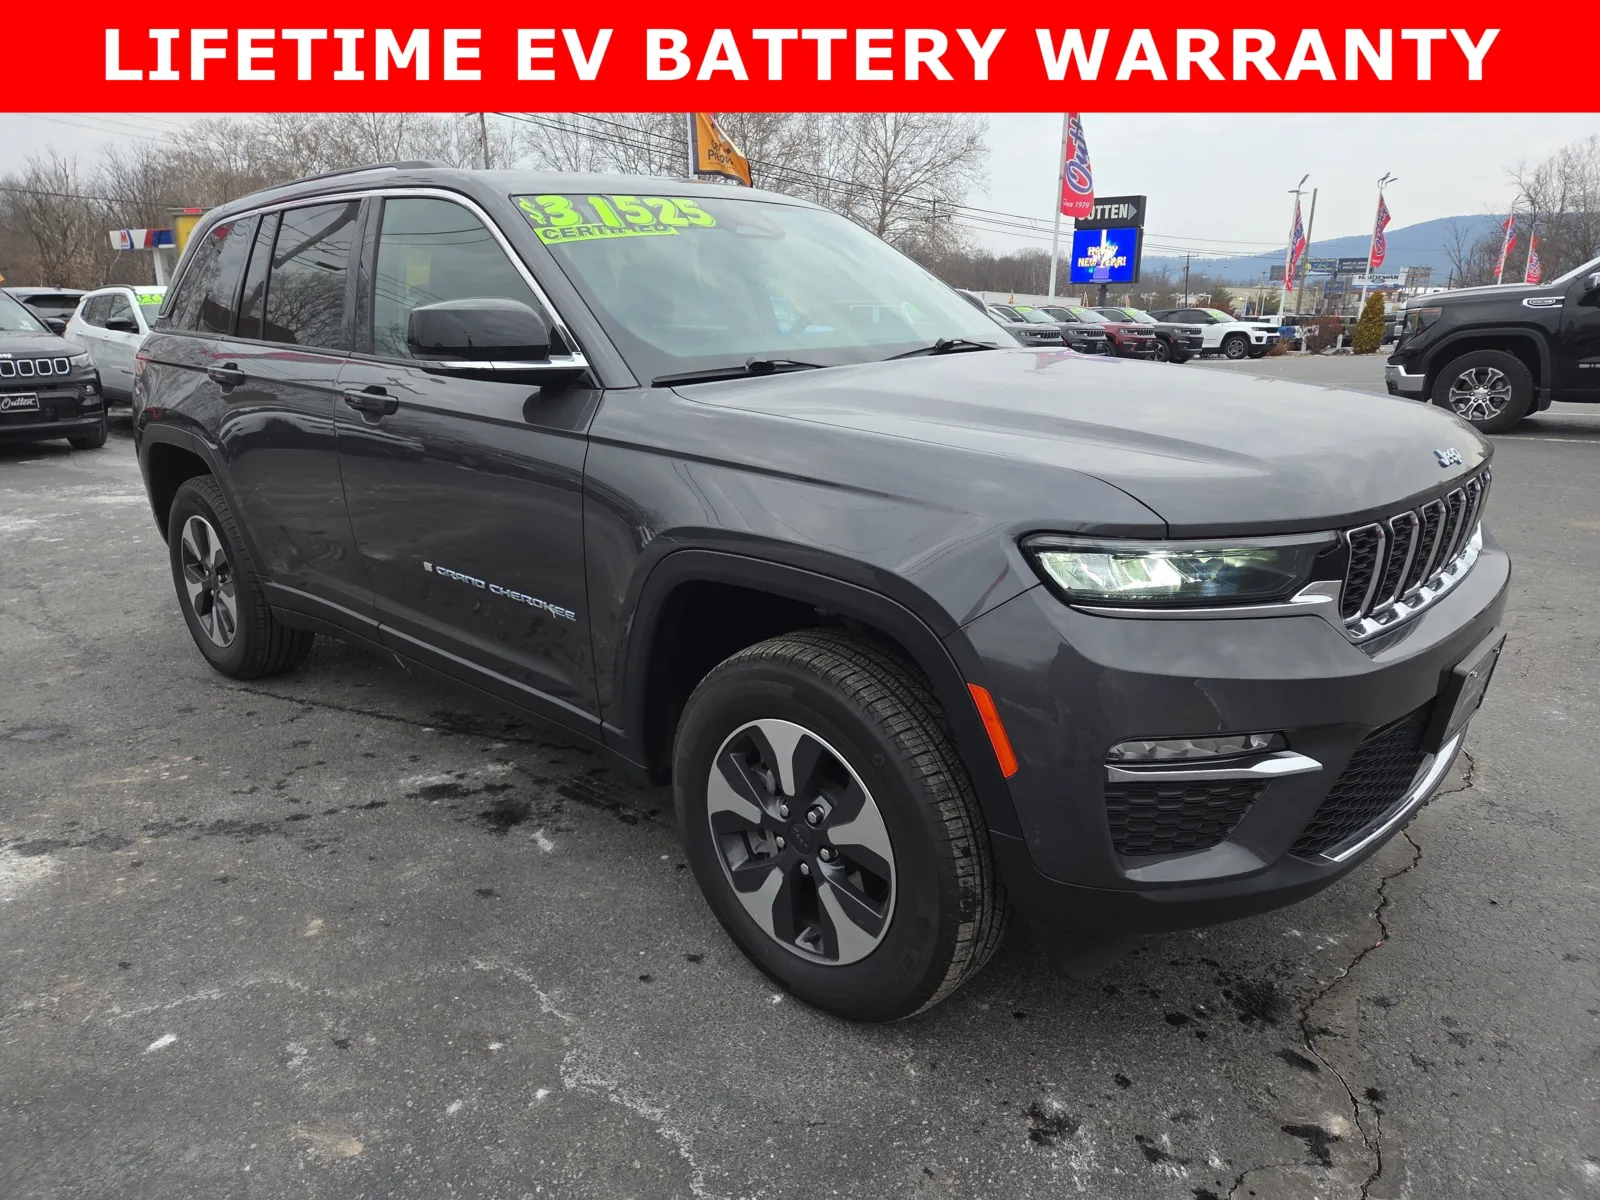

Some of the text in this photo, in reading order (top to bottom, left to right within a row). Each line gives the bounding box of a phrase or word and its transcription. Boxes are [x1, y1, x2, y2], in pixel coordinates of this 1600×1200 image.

[518, 195, 717, 228] $31525
[1075, 201, 1090, 209] 1979
[1077, 203, 1129, 221] UTTEN
[541, 225, 671, 240] CERTIFIED
[435, 566, 577, 622] GRAND CHEROKEE
